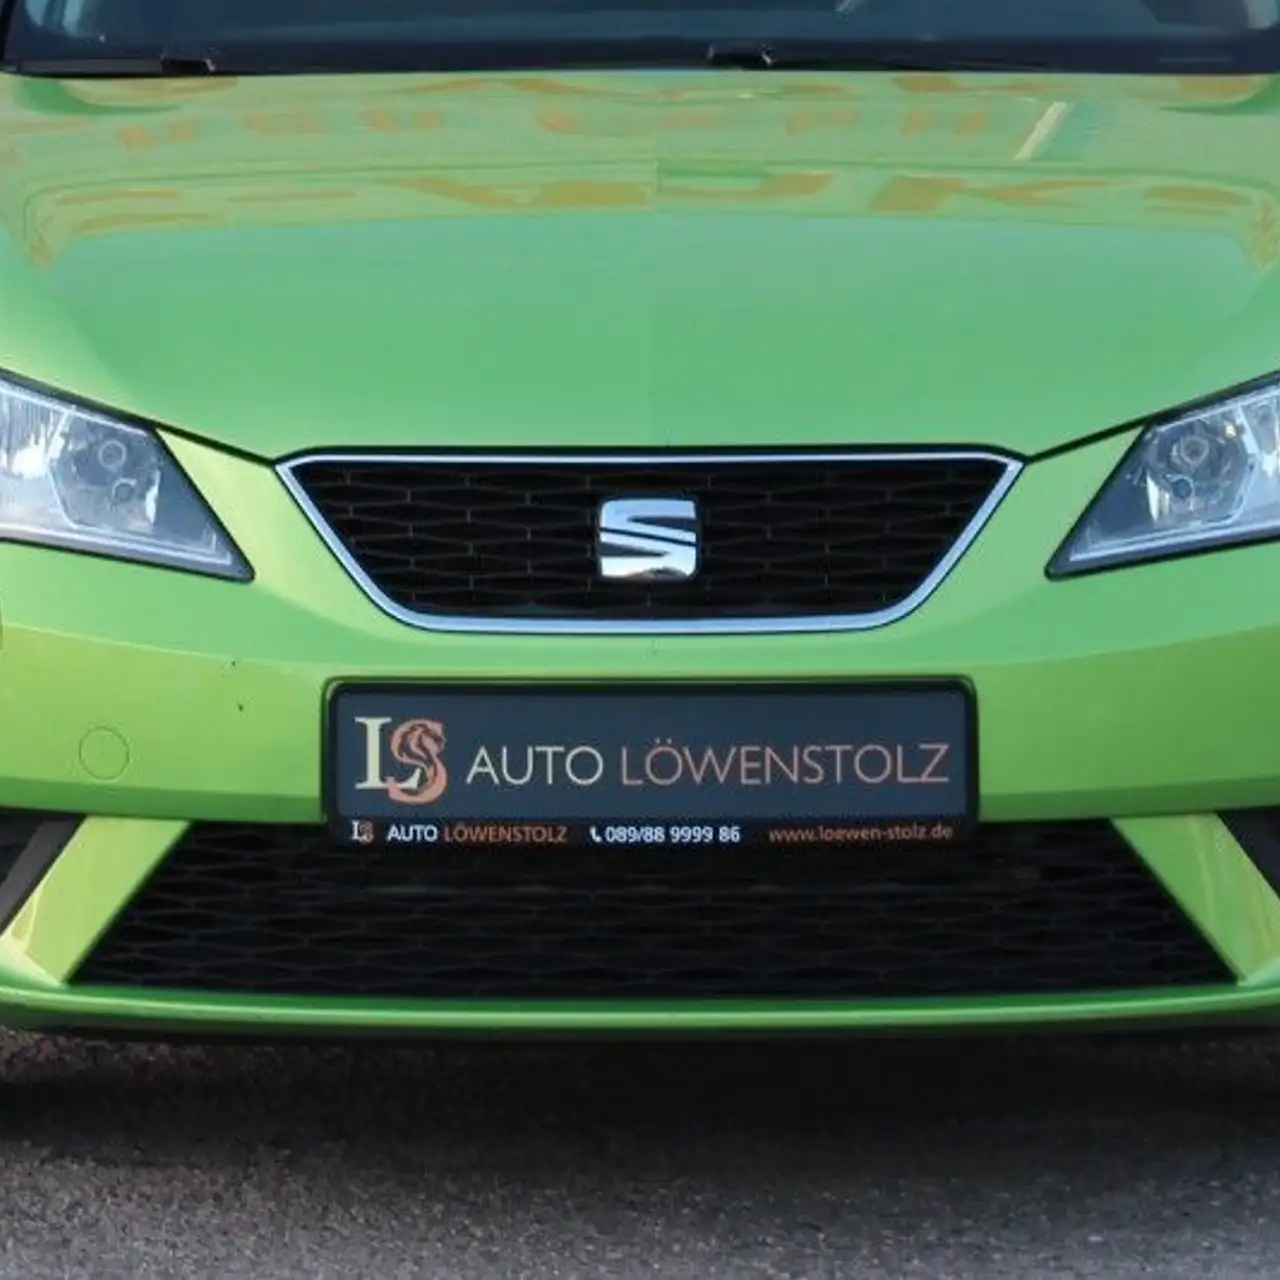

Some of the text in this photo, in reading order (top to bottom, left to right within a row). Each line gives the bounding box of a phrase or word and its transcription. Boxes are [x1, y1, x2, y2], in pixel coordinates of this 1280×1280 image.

[465, 737, 949, 786] AUTO LÖWENSTOLZ
[387, 824, 438, 843] AUTO
[605, 825, 665, 843] 089/88
[670, 825, 713, 843] 9999
[719, 825, 741, 842] 86
[769, 822, 953, 842] www.loewen-stolz.de
